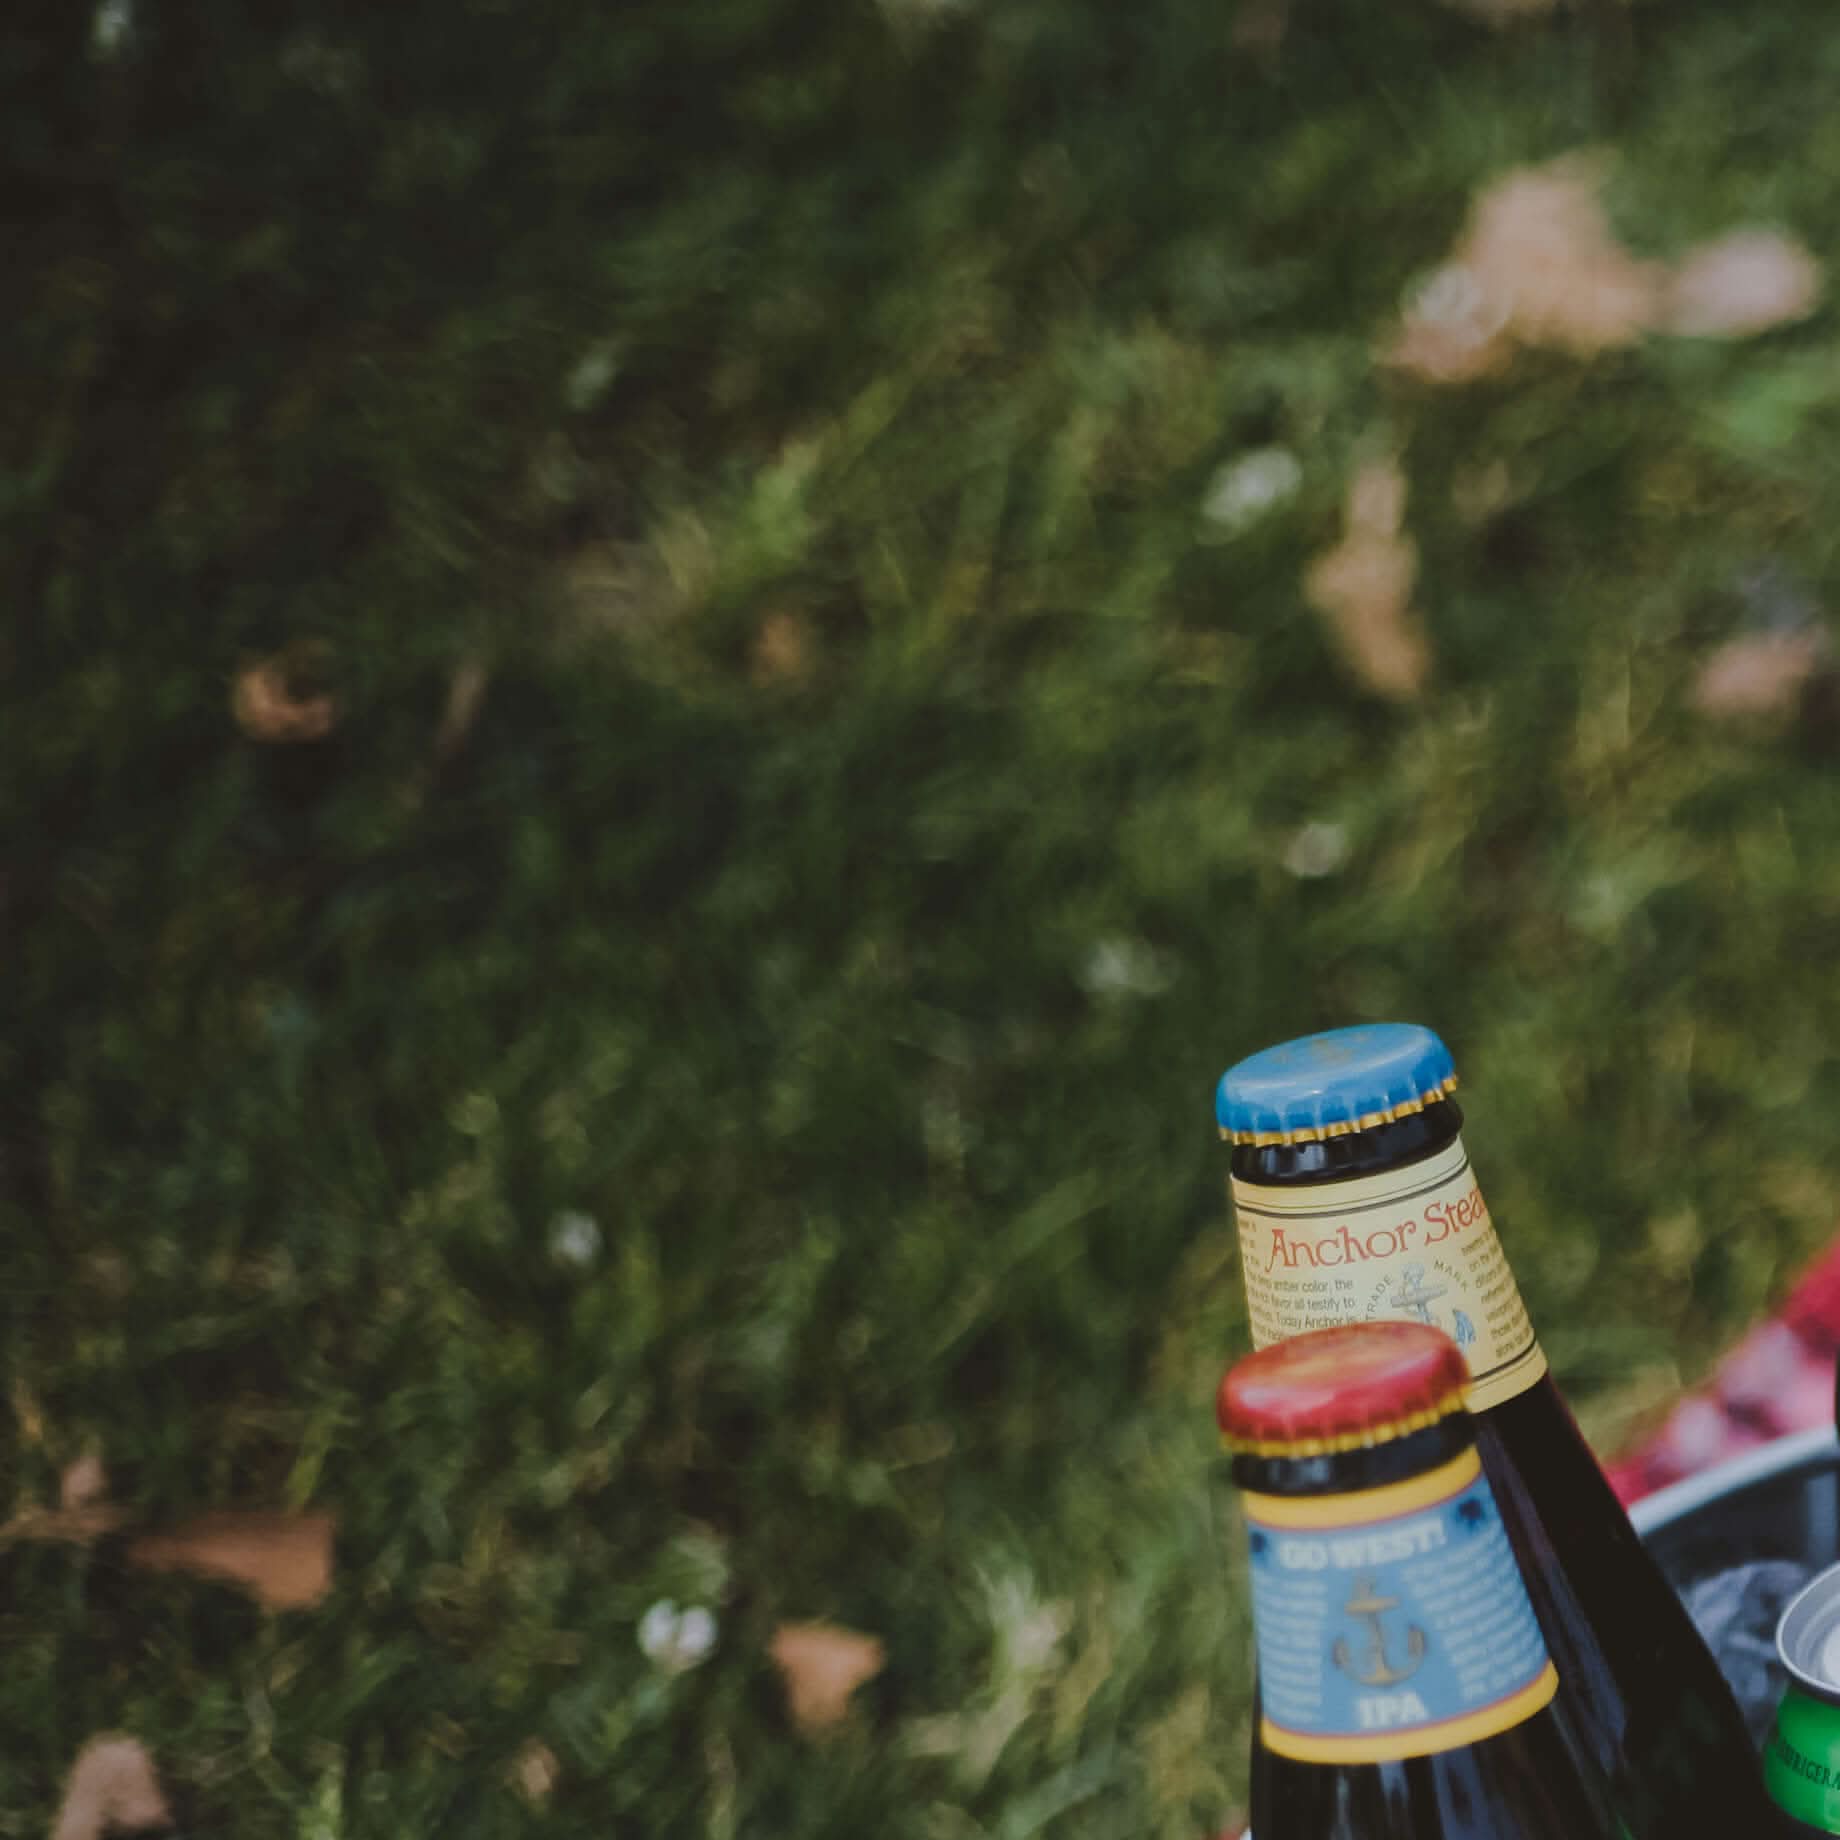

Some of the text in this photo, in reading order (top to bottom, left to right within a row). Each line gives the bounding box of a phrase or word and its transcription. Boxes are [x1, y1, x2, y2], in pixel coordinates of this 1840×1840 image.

[1265, 1219, 1417, 1273] Anchor
[1365, 1275, 1393, 1321] TRADE
[1359, 1692, 1428, 1729] IPA
